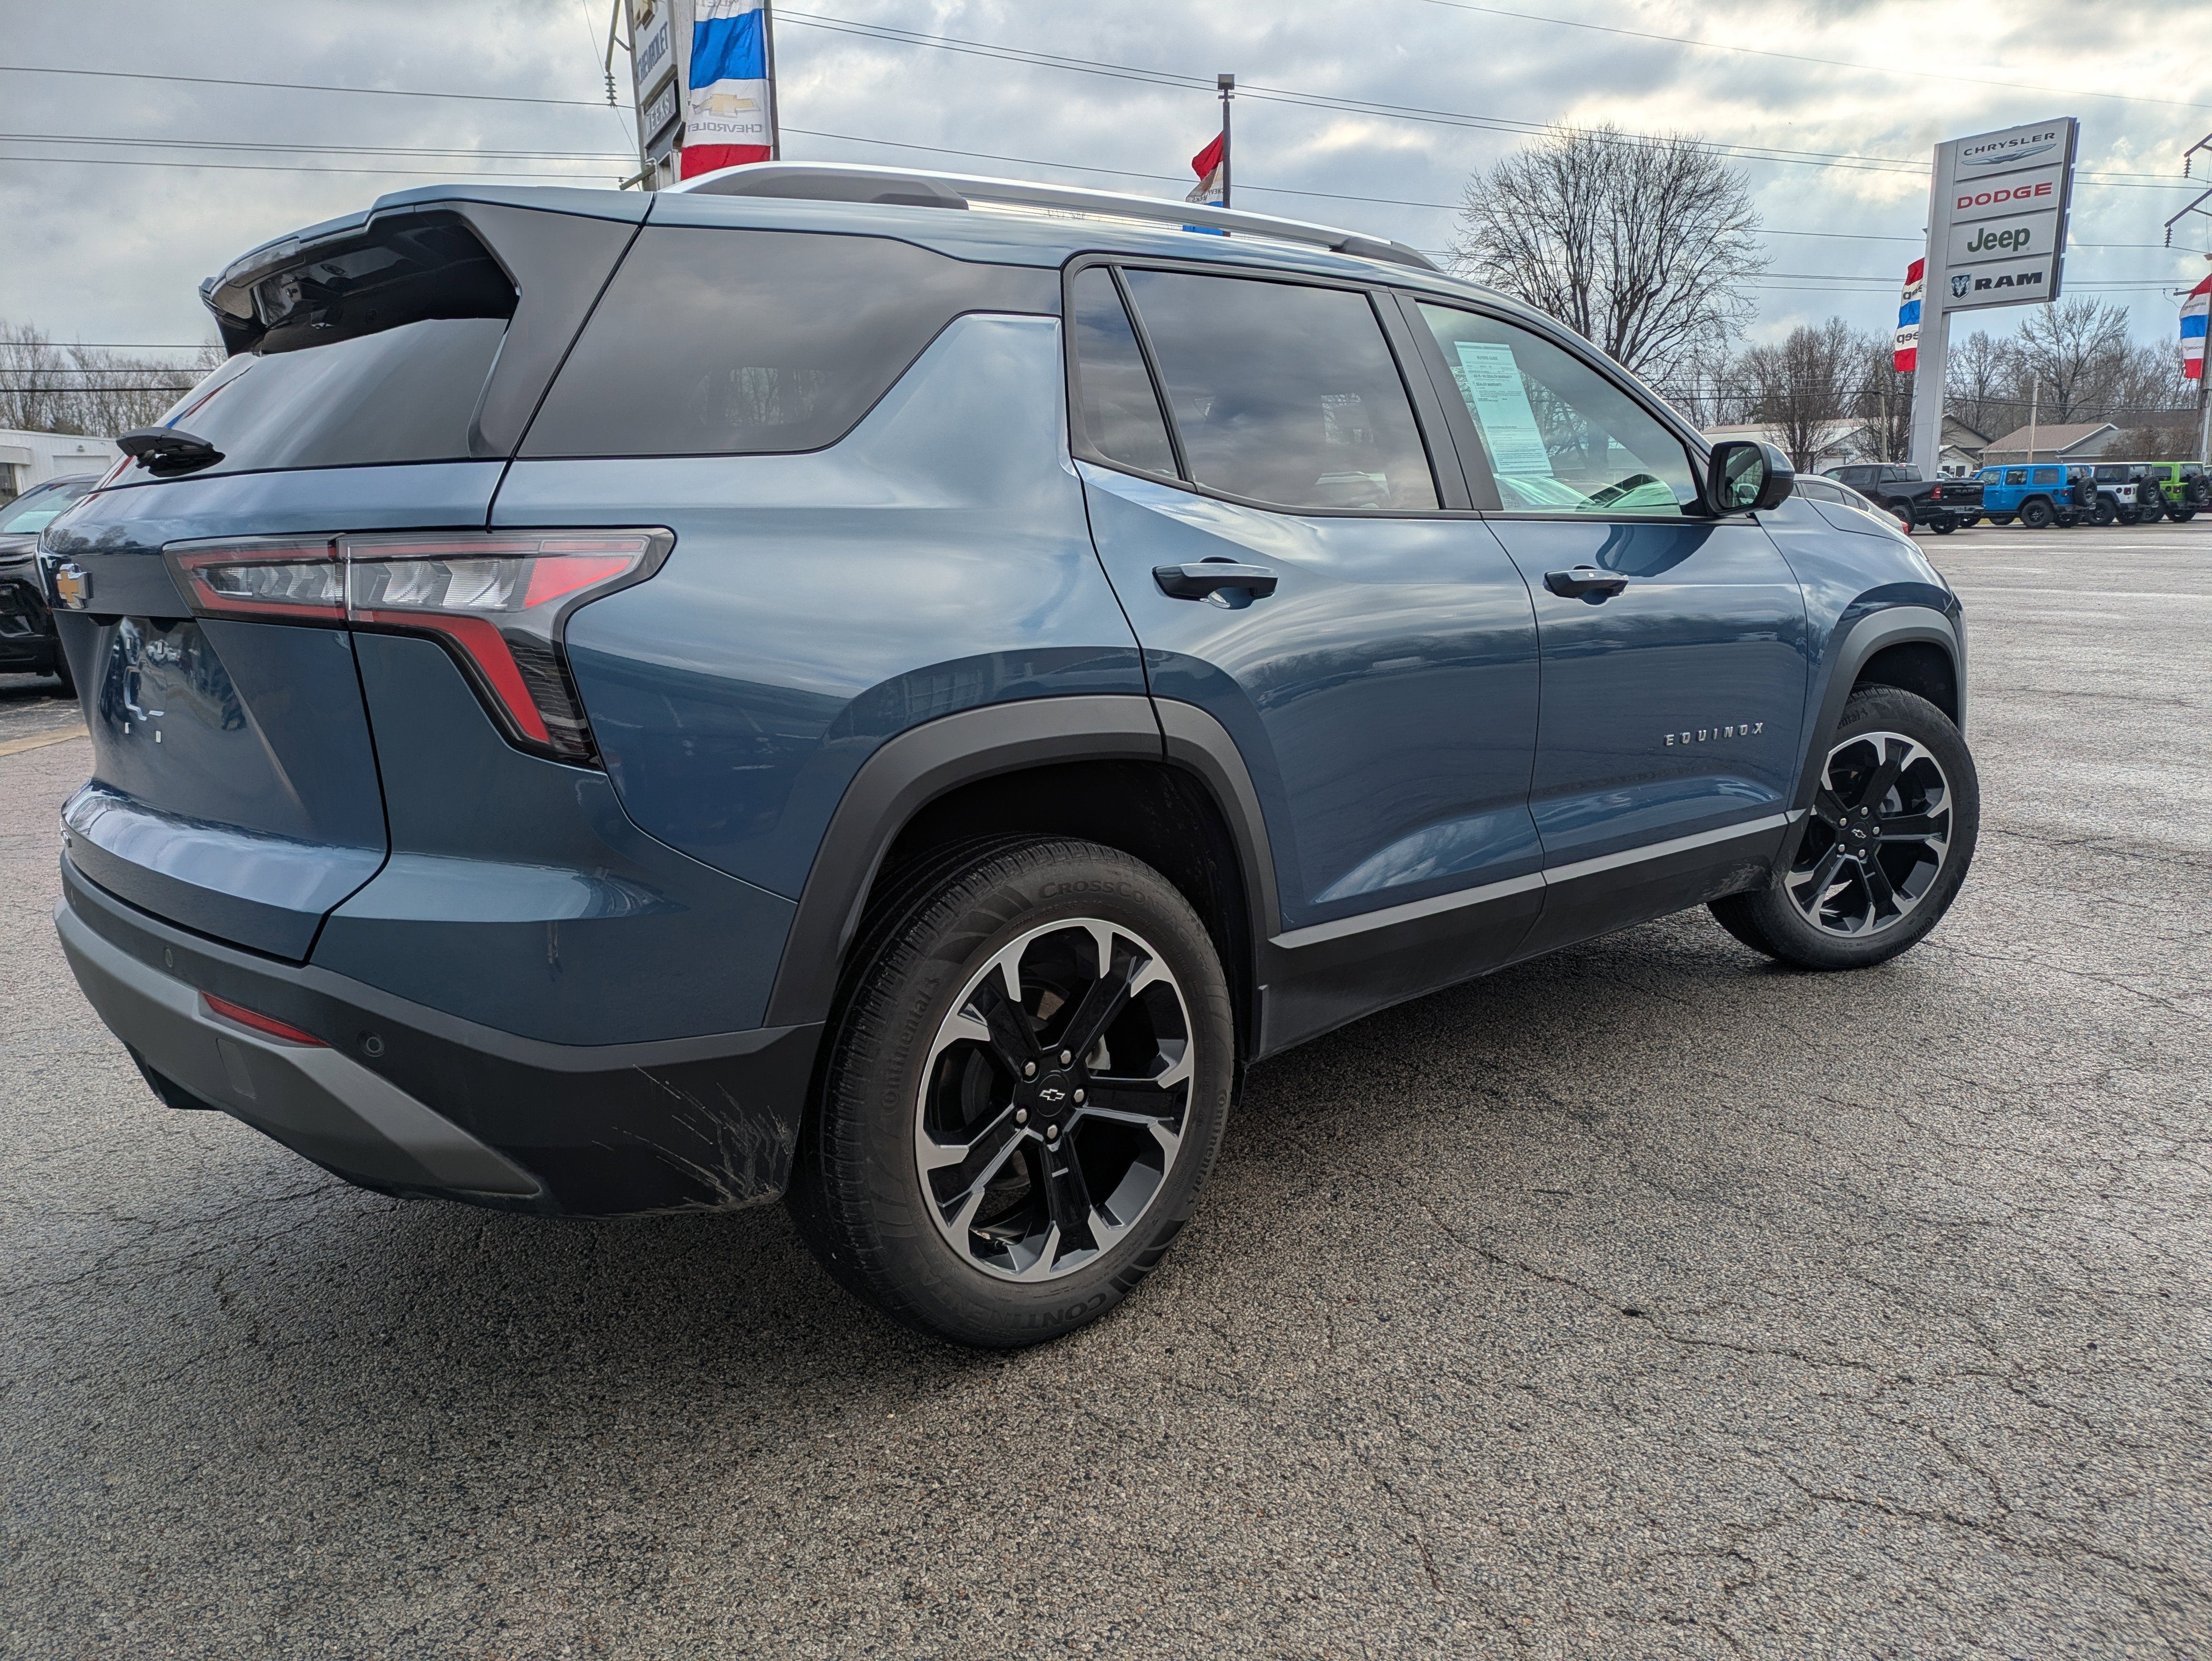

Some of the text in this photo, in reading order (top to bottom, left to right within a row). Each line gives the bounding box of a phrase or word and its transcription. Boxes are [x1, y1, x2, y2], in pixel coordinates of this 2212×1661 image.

[638, 21, 668, 86] CHEVROLET
[646, 93, 669, 137] WEEKS
[1964, 133, 2055, 156] CHRYSLER
[1957, 182, 2053, 210] DODGE
[1967, 228, 2030, 252] Jeep
[1974, 272, 2043, 291] RAM
[1664, 722, 1763, 746] EQUINOX
[881, 989, 933, 1116] Continental
[1192, 1089, 1228, 1194] Continental
